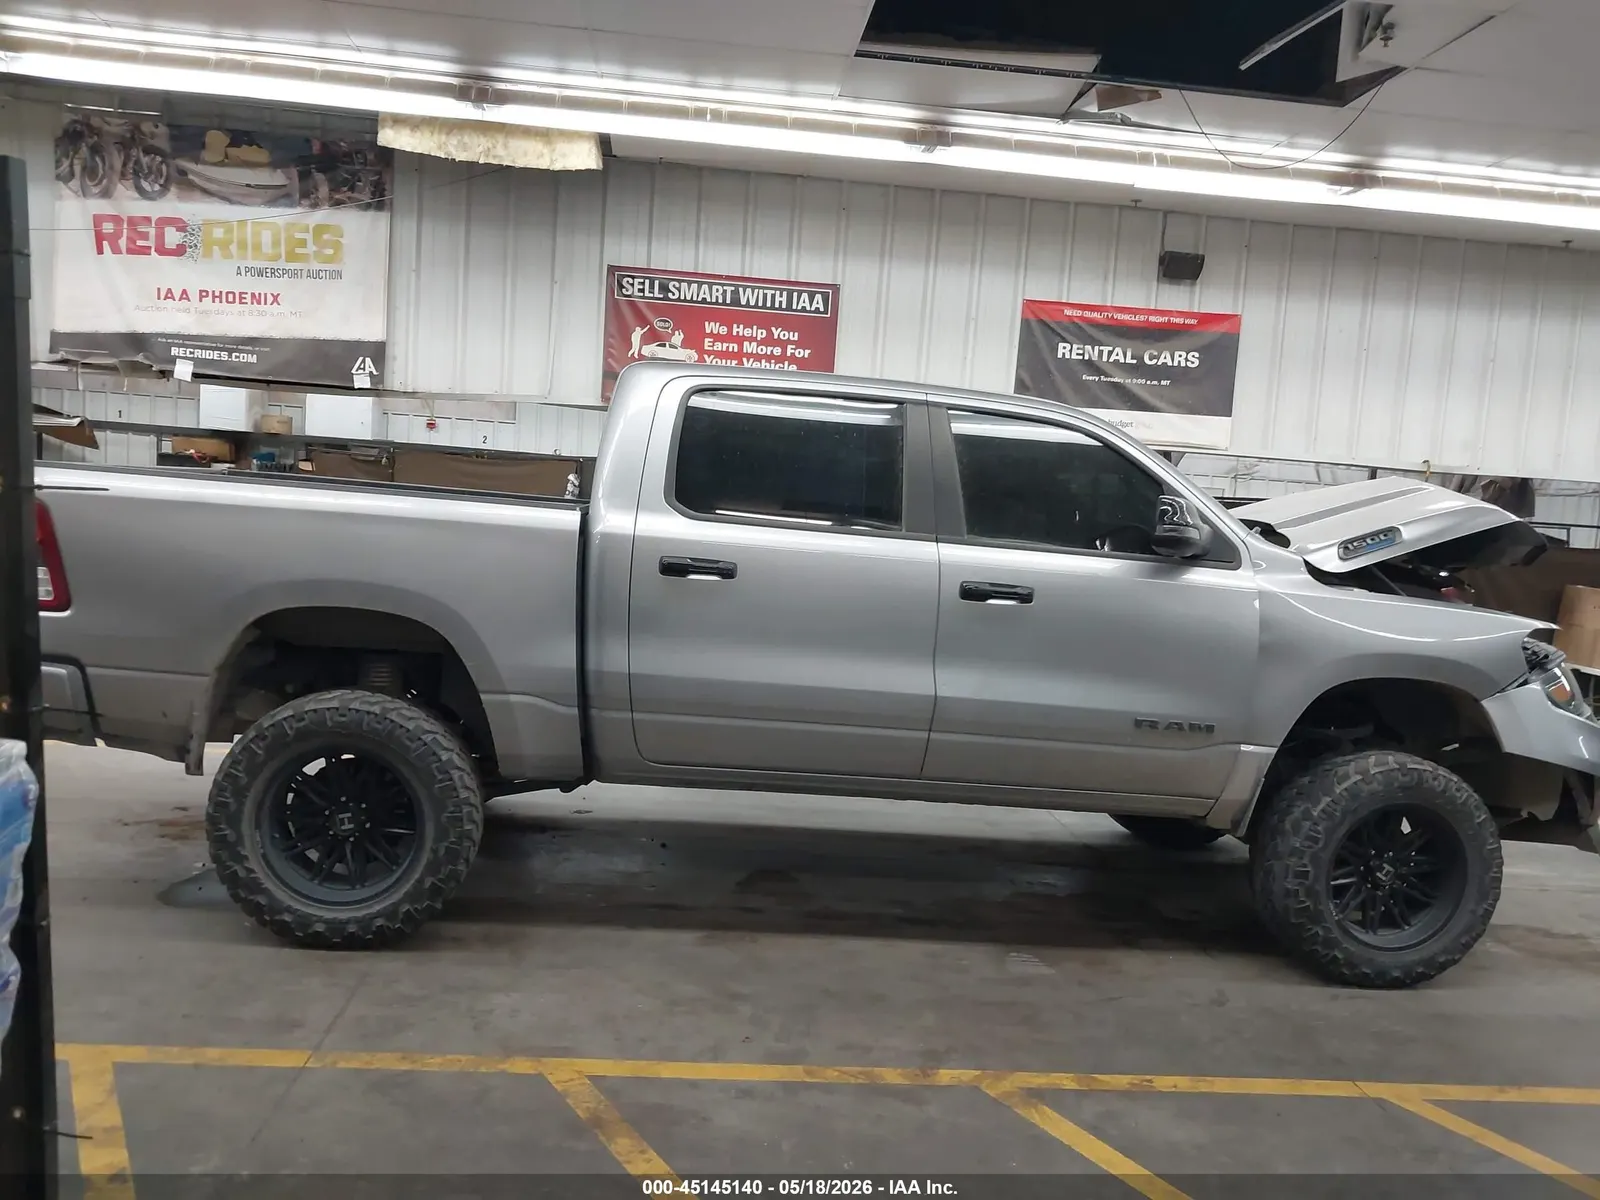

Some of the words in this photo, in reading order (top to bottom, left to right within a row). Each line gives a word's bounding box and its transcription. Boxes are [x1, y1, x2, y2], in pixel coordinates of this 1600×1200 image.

[92, 213, 188, 257] REC
[202, 219, 344, 263] RIDES
[235, 266, 243, 277] A
[244, 266, 304, 280] POWERSPORT
[305, 268, 343, 280] AUCTION
[157, 287, 191, 302] IAA
[199, 289, 281, 306] PHOENIX
[622, 277, 663, 298] SELL
[668, 282, 735, 303] SMART
[739, 288, 787, 309] WITH
[792, 292, 825, 312] IAA
[1063, 309, 1082, 317] NEED
[1083, 310, 1113, 319] QUALITY
[1113, 312, 1148, 322] VEHICLES?
[1148, 315, 1168, 323] RIGHT
[704, 321, 728, 335] We
[732, 324, 767, 341] Help
[770, 327, 799, 341] You
[170, 347, 257, 363] RECRIDES.COM
[703, 338, 738, 353] Earn
[742, 341, 781, 357] More
[787, 345, 811, 359] For
[1057, 342, 1138, 364] RENTAL
[1144, 350, 1200, 368] CARS
[1082, 374, 1099, 382] Every
[118, 410, 122, 418] 1
[482, 435, 487, 444] 2
[1134, 717, 1216, 733] RAM
